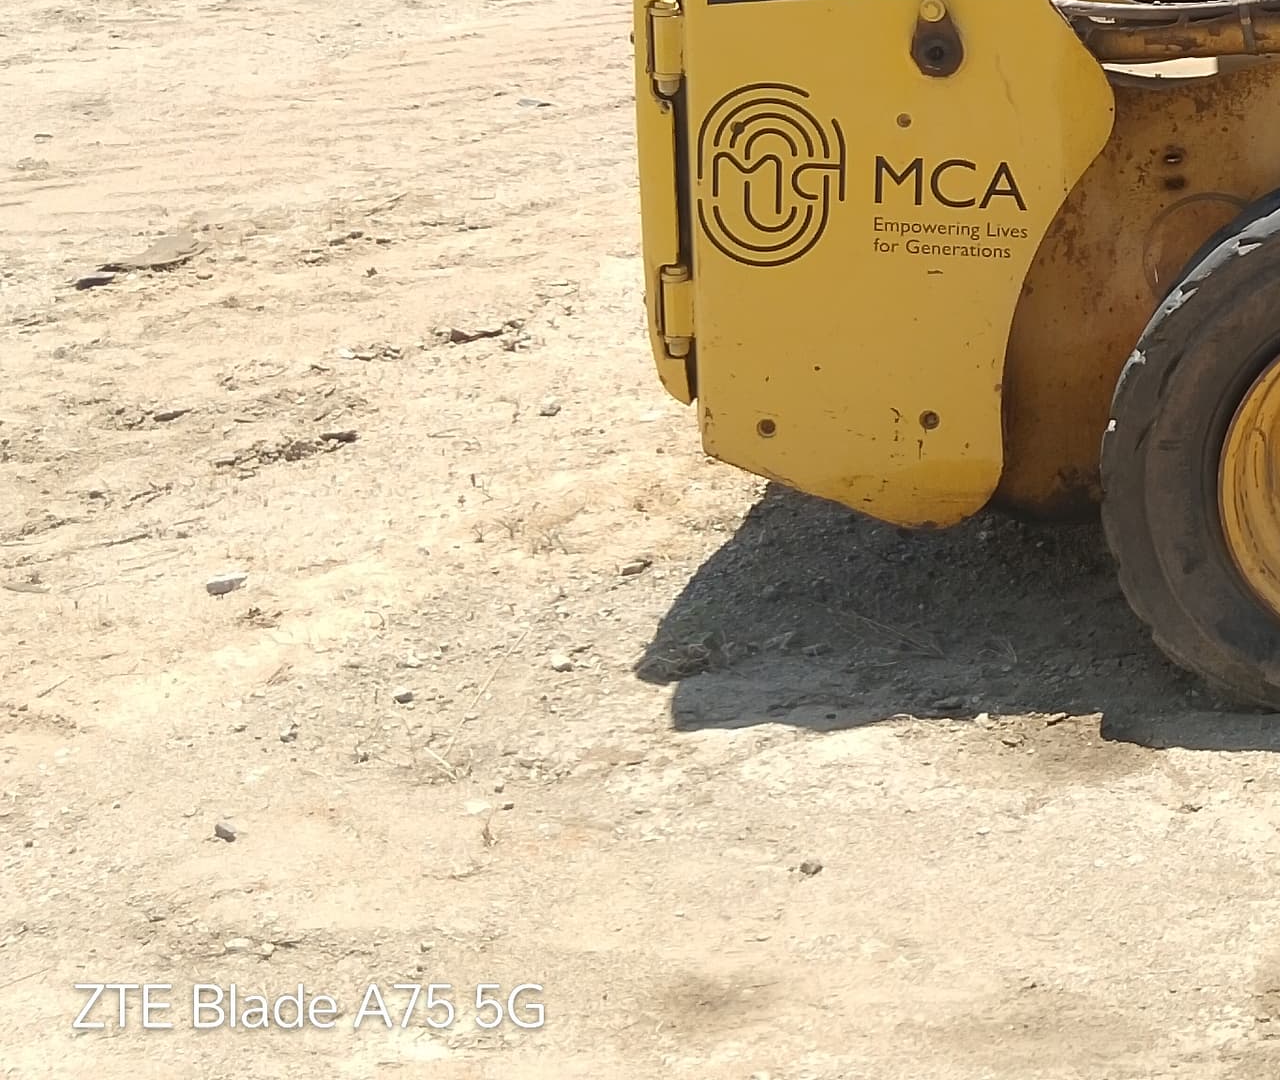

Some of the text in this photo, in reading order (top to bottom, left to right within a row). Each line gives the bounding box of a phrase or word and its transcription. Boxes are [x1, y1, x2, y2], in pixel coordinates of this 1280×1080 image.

[874, 155, 1028, 211] MCA
[873, 216, 1028, 240] Empowering Lives
[873, 237, 1012, 259] for Generations
